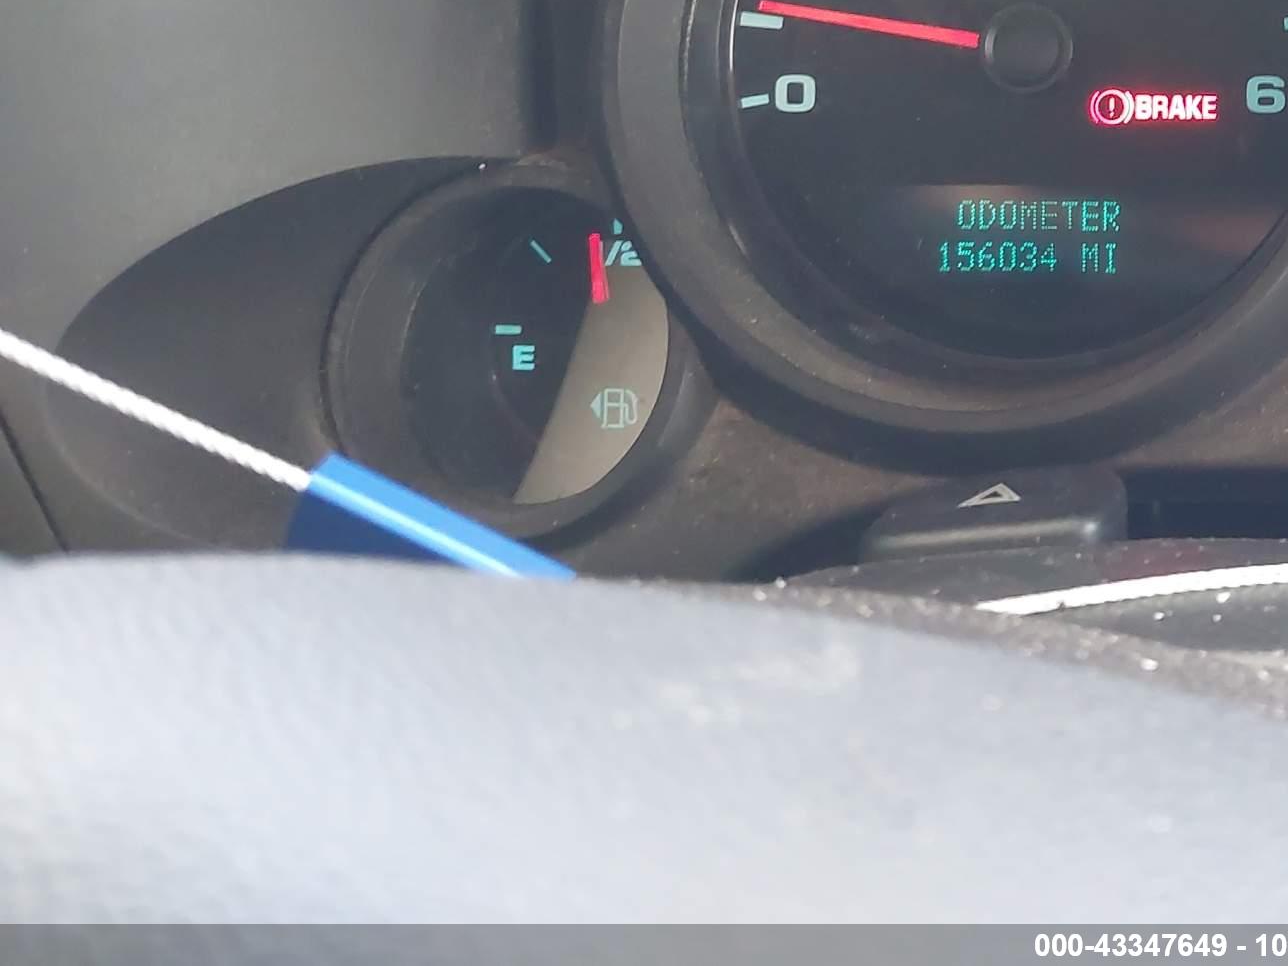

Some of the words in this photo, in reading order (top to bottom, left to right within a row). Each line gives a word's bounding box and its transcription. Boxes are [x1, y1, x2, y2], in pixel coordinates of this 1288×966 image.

[775, 74, 816, 112] 0
[1135, 95, 1217, 120] BRAKE
[1246, 76, 1285, 114] 6
[958, 200, 1120, 231] ODOMETER
[939, 242, 1057, 272] 156034
[1082, 242, 1117, 272] MI
[512, 345, 535, 370] E
